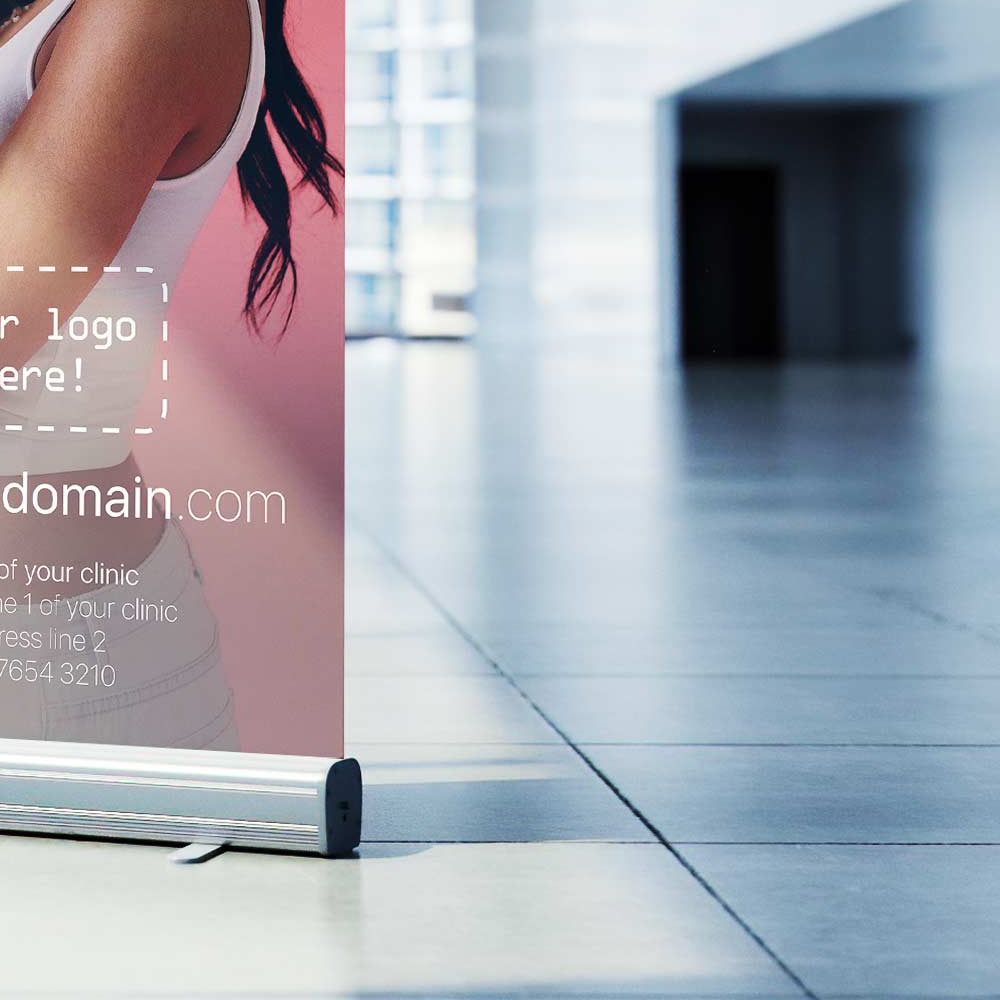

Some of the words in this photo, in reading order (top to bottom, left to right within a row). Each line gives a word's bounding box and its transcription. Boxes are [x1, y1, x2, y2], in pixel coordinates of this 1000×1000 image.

[47, 307, 137, 350] logo
[24, 564, 75, 586] your
[80, 561, 140, 587] clinic
[22, 592, 33, 616] 1
[39, 593, 61, 617] of
[66, 599, 116, 622] your
[121, 597, 179, 623] clinic
[49, 627, 87, 652] line
[93, 630, 107, 653] 2
[60, 662, 117, 688] 3210
